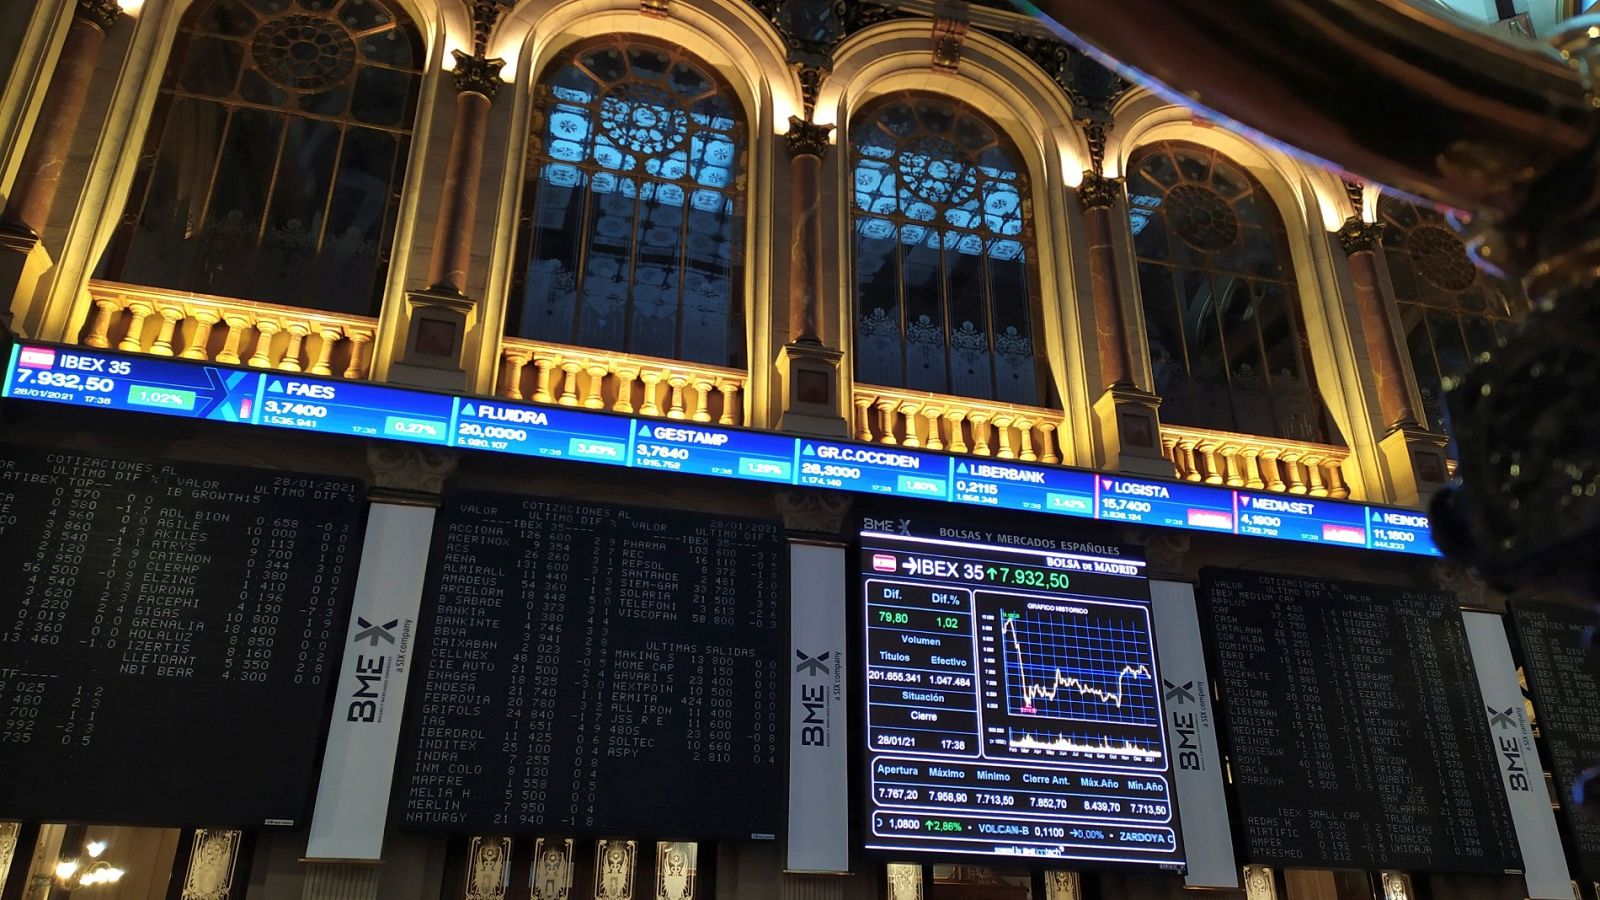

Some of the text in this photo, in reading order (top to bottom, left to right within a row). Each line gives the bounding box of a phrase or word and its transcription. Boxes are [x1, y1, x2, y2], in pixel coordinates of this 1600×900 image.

[60, 354, 131, 376] IBEX 35
[17, 368, 114, 393] 7.932,50
[13, 387, 112, 405] 28/01/2021 17:38
[286, 382, 335, 400] FAES
[264, 401, 328, 418] 3,7400
[478, 405, 548, 426] FLUIDRA
[352, 426, 377, 435] 17:38
[458, 422, 527, 442] 20,0000
[653, 427, 728, 446] GESTAMP
[816, 445, 920, 469] GR.C.OCCIDEN
[47, 454, 178, 475] COTIZACIONES AL
[53, 465, 141, 481] ULTIMO DIF
[970, 463, 1046, 484] LIBERBANK
[273, 476, 355, 493] 28/01/2021
[956, 480, 999, 495] 0,2115
[1115, 481, 1169, 498] LOGISTA
[166, 487, 261, 504] IB GROWTH15
[522, 500, 611, 517] COTIZACIONES
[1102, 497, 1151, 513] 15,7400
[1251, 498, 1315, 515] MEDIASET
[160, 508, 230, 522] ADL BION
[1383, 512, 1429, 528] NEINOR
[449, 523, 504, 536] ACCIONA
[863, 517, 895, 532] BME
[152, 540, 196, 552] ATRYS
[447, 533, 511, 546] ACERINOX
[623, 539, 667, 551] PHARMA
[939, 527, 1120, 556] BOLSAS Y MERCADOS ESPAÑOLES
[149, 550, 212, 564] CATENON
[621, 559, 665, 571] REPSOL
[917, 558, 985, 580] IBEX 35
[1046, 556, 1081, 570] BOLSA
[1094, 561, 1139, 576] MADRID
[441, 574, 497, 586] AMADEUS
[620, 569, 680, 582] SANTANDE
[999, 567, 1070, 590] 7.932,50
[140, 583, 195, 596] EURONA
[440, 583, 504, 597] ARCELORM
[620, 579, 679, 591] SIEM-GAM
[619, 589, 672, 601] SOLARIA
[883, 588, 903, 600] Dif.
[931, 592, 961, 606] Dif.%
[137, 594, 200, 609] FACEPHI
[619, 598, 677, 611] TELEFONI
[618, 608, 678, 621] VISCOFAN
[878, 611, 909, 624] 79,80
[131, 618, 205, 632] GRENALIA
[435, 615, 500, 629] BANKINTE
[936, 617, 959, 629] 1,02
[128, 629, 193, 642] HOLALUZ
[400, 618, 414, 654] company
[434, 626, 467, 637] BBVA
[432, 637, 498, 650] CAIXABAN
[901, 634, 942, 646] Volumen
[126, 641, 190, 654] IZERTIS
[431, 648, 488, 660] CELLNEX
[646, 641, 756, 658] ULTIMAS SALIDAS
[122, 652, 197, 666] LLEIDANT
[396, 655, 405, 667] SIX
[930, 655, 968, 667] Efectivo
[119, 663, 195, 678] NBI BEAR
[834, 651, 843, 682] company
[427, 670, 477, 682] ENAGAS
[868, 670, 921, 684] 201.655.341
[928, 675, 971, 688] 1.047.484
[347, 655, 385, 723] BME
[425, 681, 476, 693] ENDESA
[612, 681, 674, 694] NEXTPOIN
[833, 685, 841, 696] SIX
[423, 691, 491, 705] FERROVIA
[611, 692, 658, 703] ERMITA
[901, 691, 945, 703] Situación
[1197, 680, 1207, 710] company
[422, 704, 481, 717] GRIFOLS
[801, 684, 825, 747] BME
[910, 710, 938, 722] Cierre
[1200, 711, 1208, 723] SIX
[1516, 706, 1528, 736] company
[420, 727, 486, 741] IBERDROL
[1172, 711, 1201, 771] BME
[417, 738, 477, 751] INDITEX
[608, 735, 656, 748] SOLTEC
[877, 735, 916, 748] 28/01/21
[941, 739, 966, 751] 17:38
[1520, 736, 1531, 747] SIX
[607, 747, 640, 759] ASPY
[1498, 736, 1530, 792] BME
[411, 775, 465, 787] MAPFRE
[877, 763, 919, 777] Apertura
[928, 767, 965, 779] Máximo
[976, 769, 1011, 782] Mínimo
[1022, 773, 1050, 785] Cierre
[1052, 775, 1071, 786] Ant.
[407, 799, 460, 811] MERLIN
[878, 788, 1167, 816] 7.767,20 7.958,90 7.713,50 7.852,70 8.439,70 7.713,50
[405, 811, 468, 824] NATURGY
[889, 818, 1165, 843] 1,0800 2,86% VOLCAN-B 0,1100 0,00% ZARDOYA
